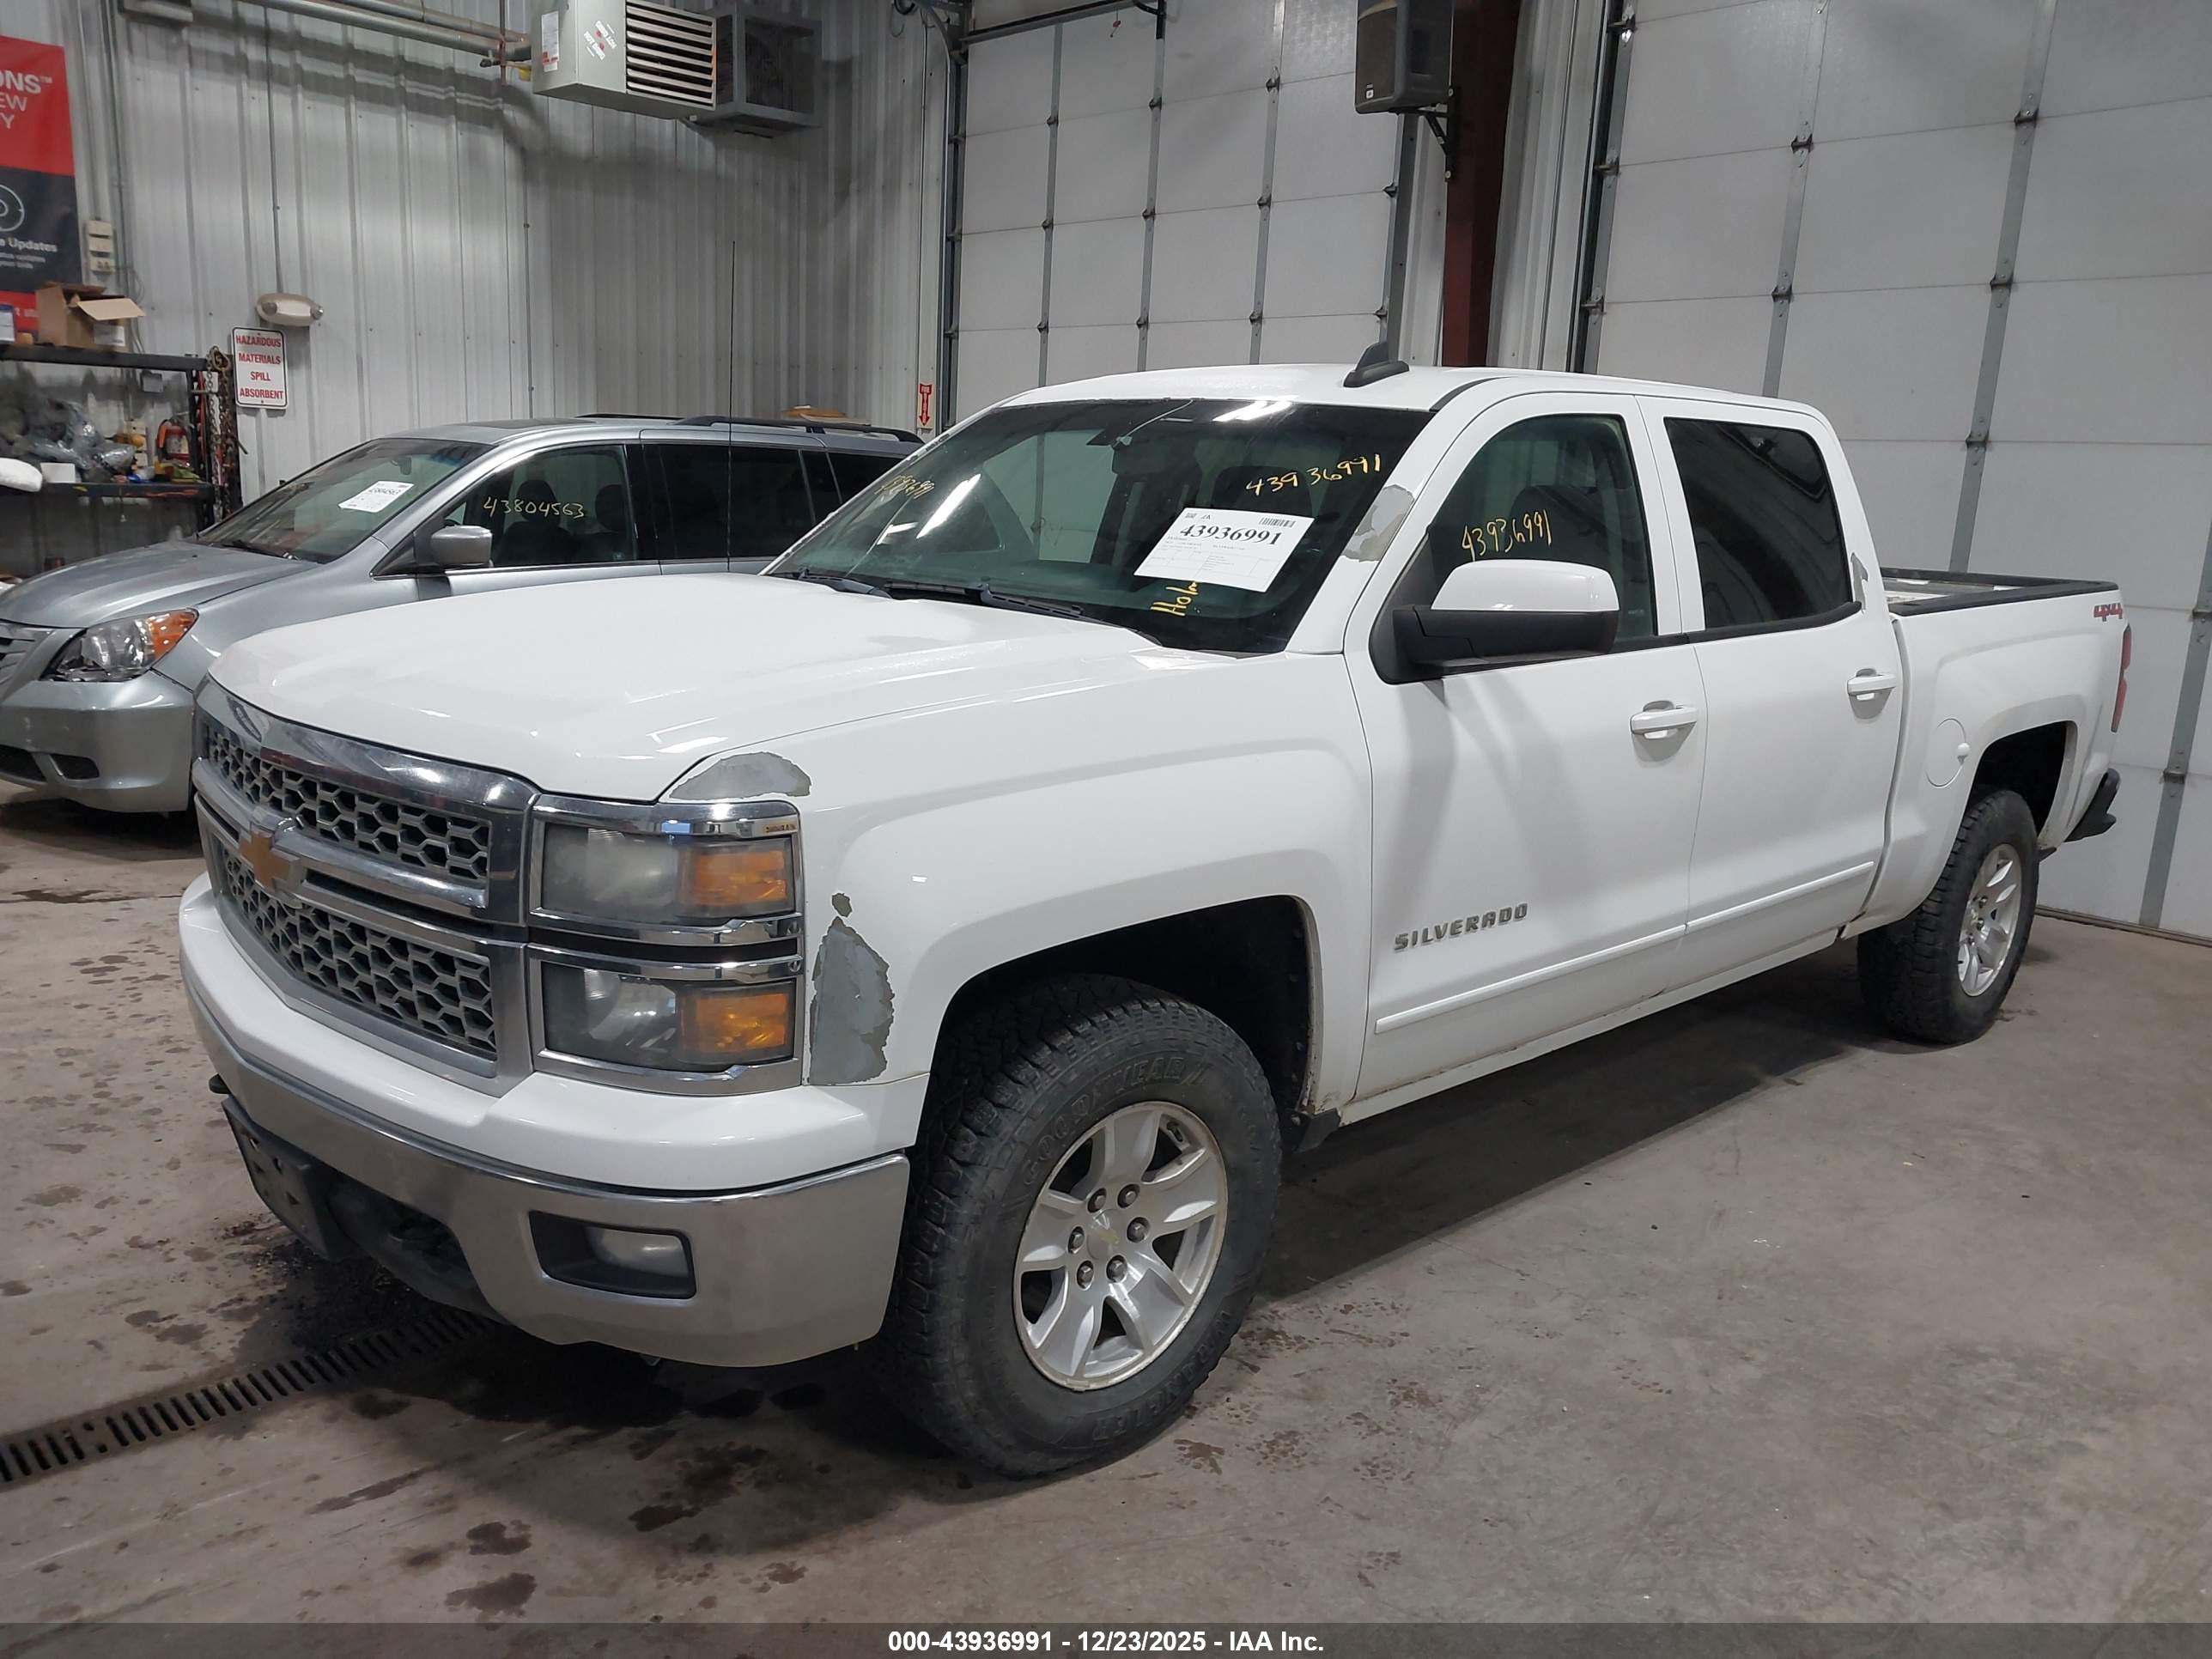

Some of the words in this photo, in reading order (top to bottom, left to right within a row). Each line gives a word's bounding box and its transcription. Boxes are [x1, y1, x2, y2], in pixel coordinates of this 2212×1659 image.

[8, 237, 58, 252] Updates
[236, 335, 282, 347] HAZARDOUS
[239, 353, 282, 365] MATERIALS
[250, 371, 271, 381] SPILL
[240, 387, 284, 399] ABSORBENT
[483, 496, 585, 519] 43804563
[1180, 524, 1282, 545] 43936991
[1394, 902, 1528, 951] SILVERADO
